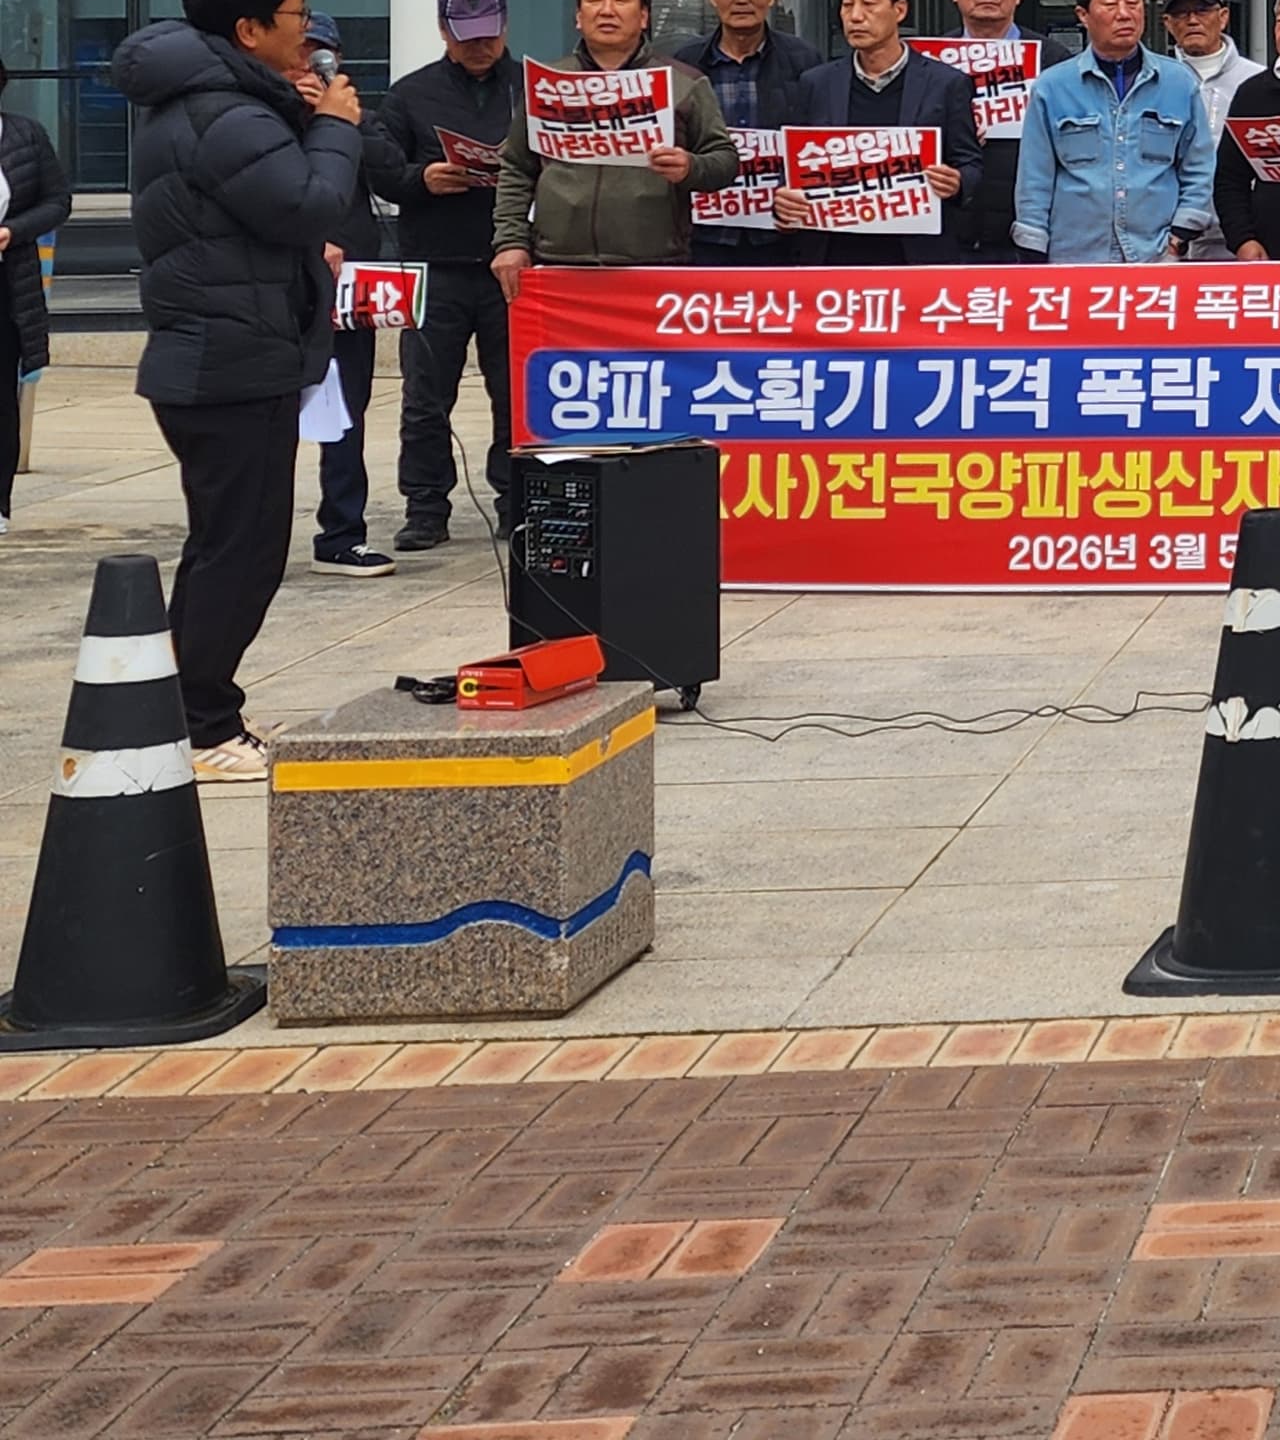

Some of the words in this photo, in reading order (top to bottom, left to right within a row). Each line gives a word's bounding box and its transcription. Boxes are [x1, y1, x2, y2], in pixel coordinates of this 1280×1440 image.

[921, 41, 1026, 74] 입양파
[534, 72, 656, 106] 수입양파
[729, 131, 782, 161] 양파
[797, 130, 923, 171] 수입양파
[801, 187, 931, 228] 마련하라!
[656, 292, 801, 335] 26년산
[816, 287, 906, 334] 양파
[920, 287, 1011, 334] 수확
[1026, 286, 1071, 331] 전
[1088, 285, 1177, 331] 각격
[548, 358, 670, 431] 양파
[690, 358, 887, 431] 수확기
[915, 356, 1053, 429] 가격
[1077, 356, 1220, 428] 폭락
[1009, 533, 1136, 570] 2026년
[1149, 533, 1206, 569] 3월
